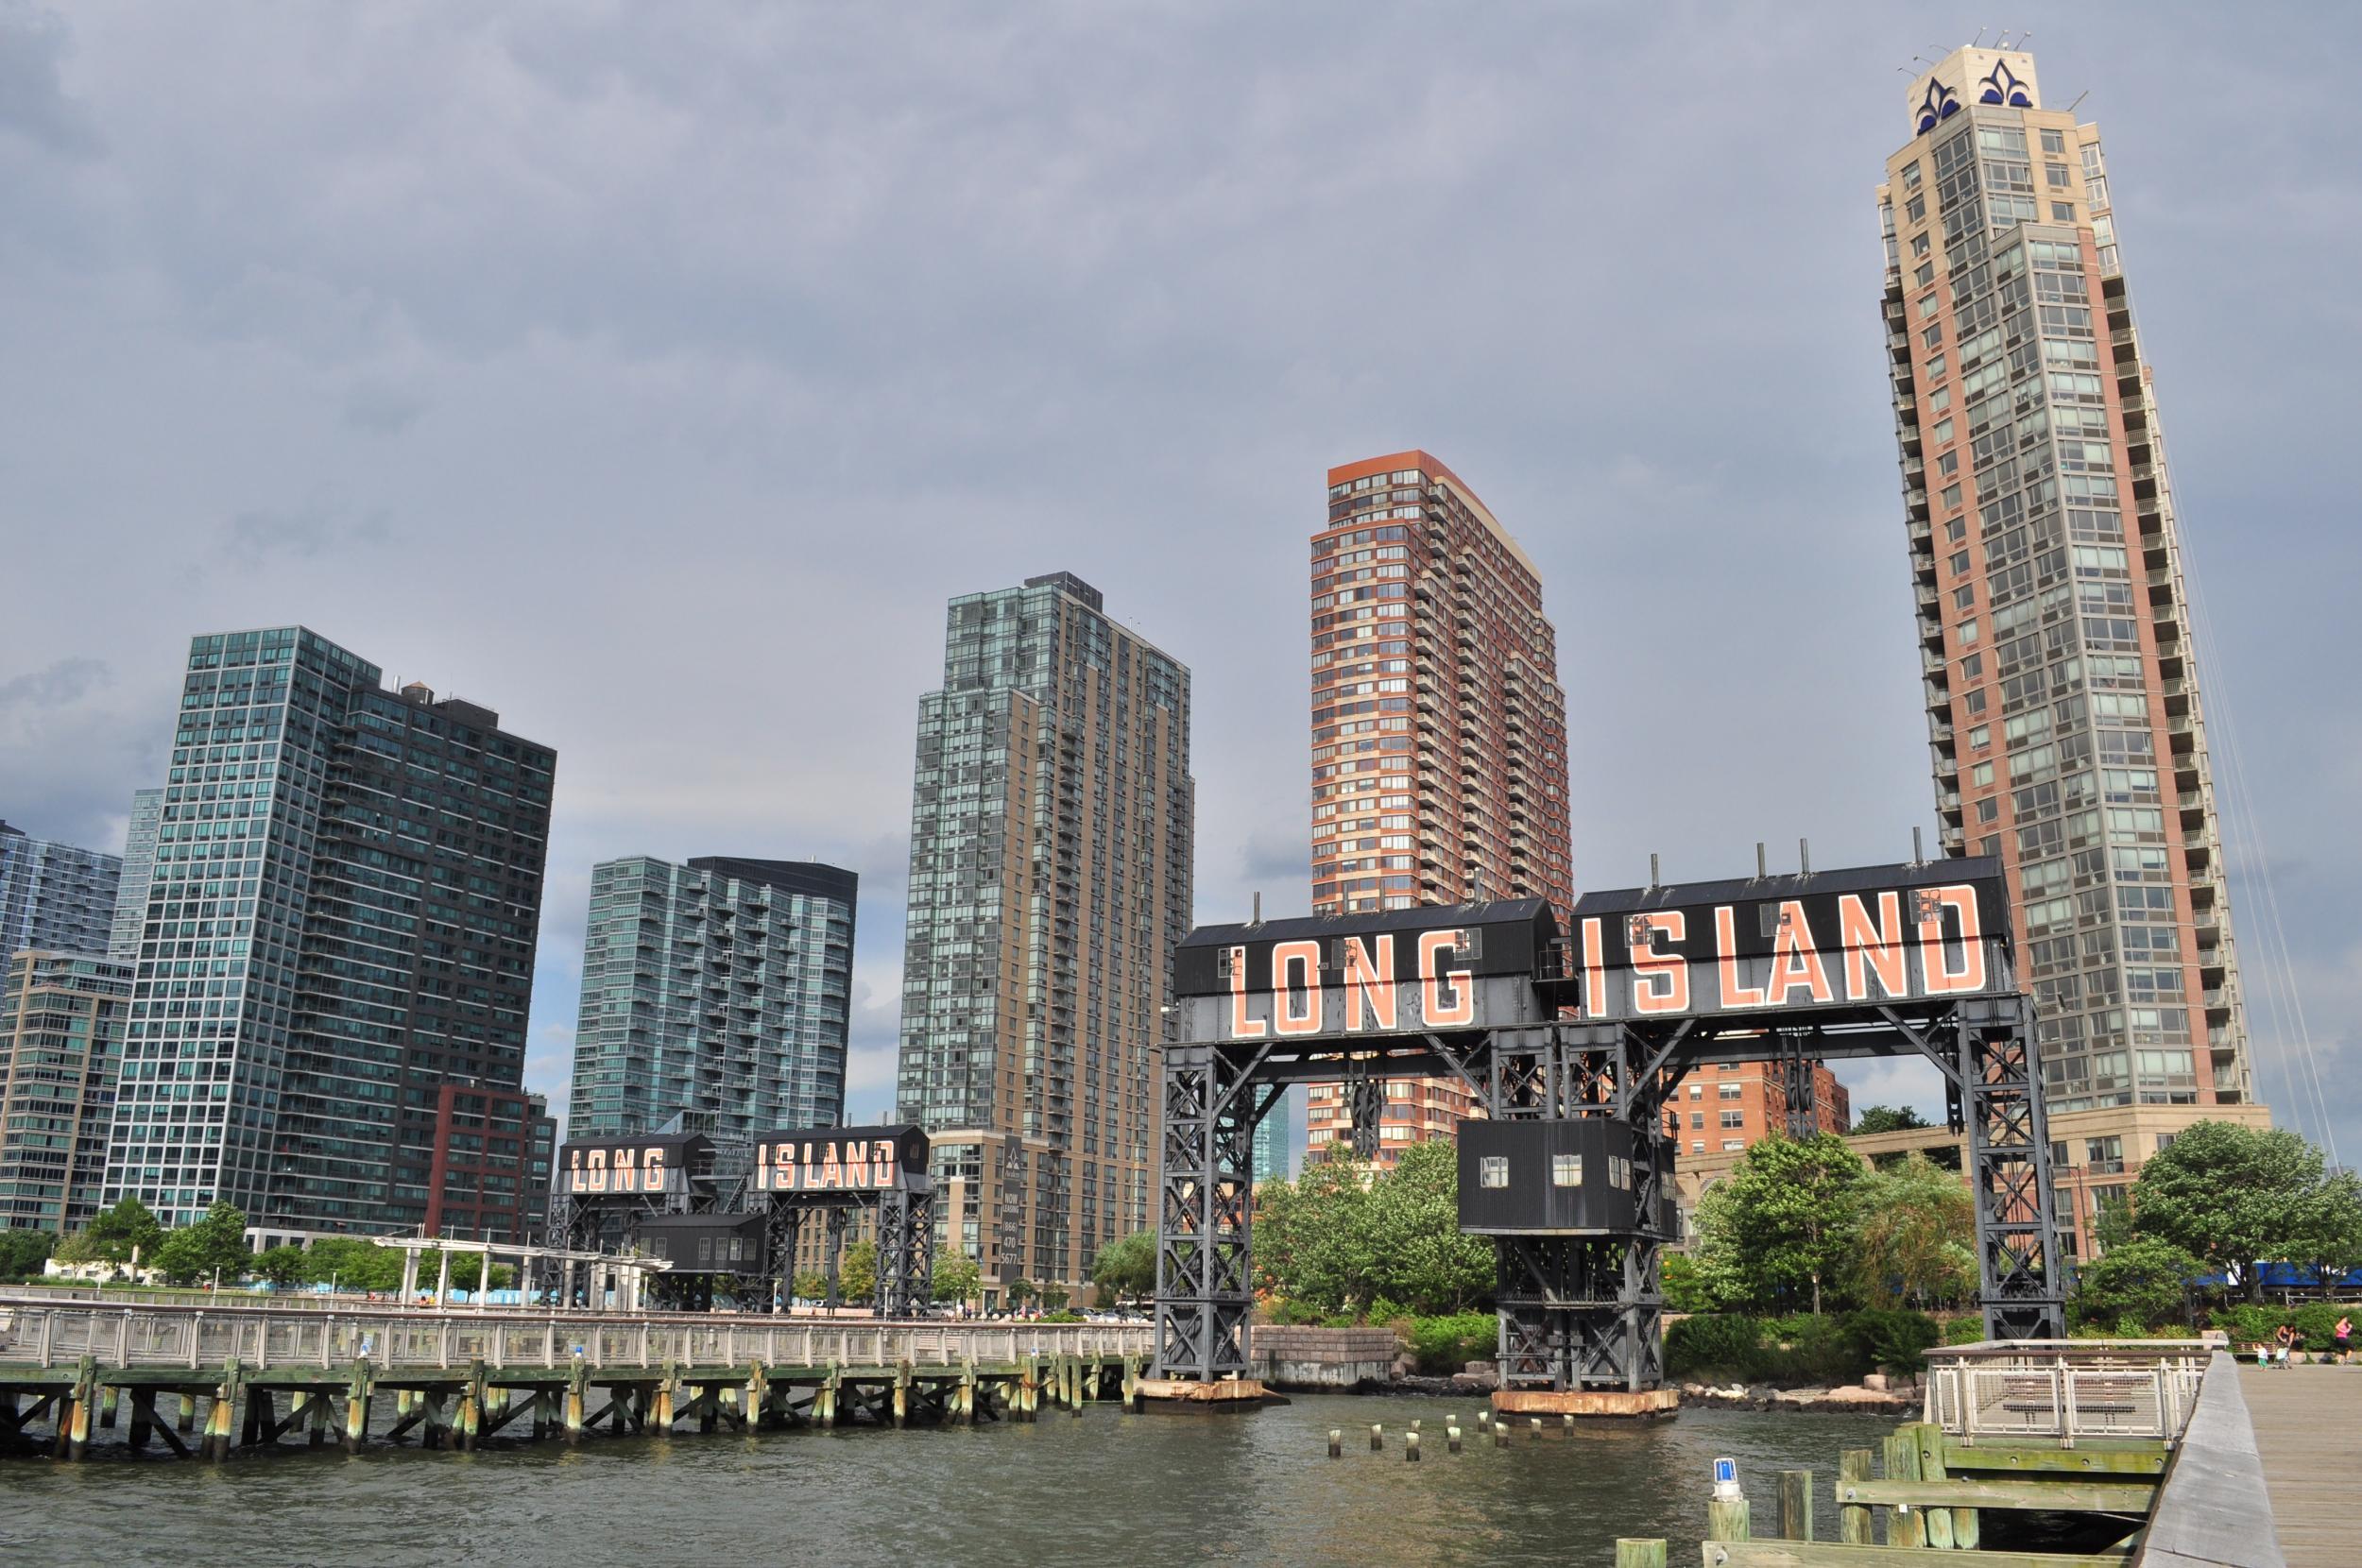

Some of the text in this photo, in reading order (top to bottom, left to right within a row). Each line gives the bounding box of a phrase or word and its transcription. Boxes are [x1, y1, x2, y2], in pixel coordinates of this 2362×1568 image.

[1230, 884, 1985, 1038] LONG ISLAND
[571, 1140, 895, 1192] LONG ISLAND
[1004, 1193, 1018, 1204] NOW
[1002, 1204, 1019, 1214] LEASING
[1003, 1236, 1016, 1248] 470
[1001, 1253, 1018, 1264] 5677
